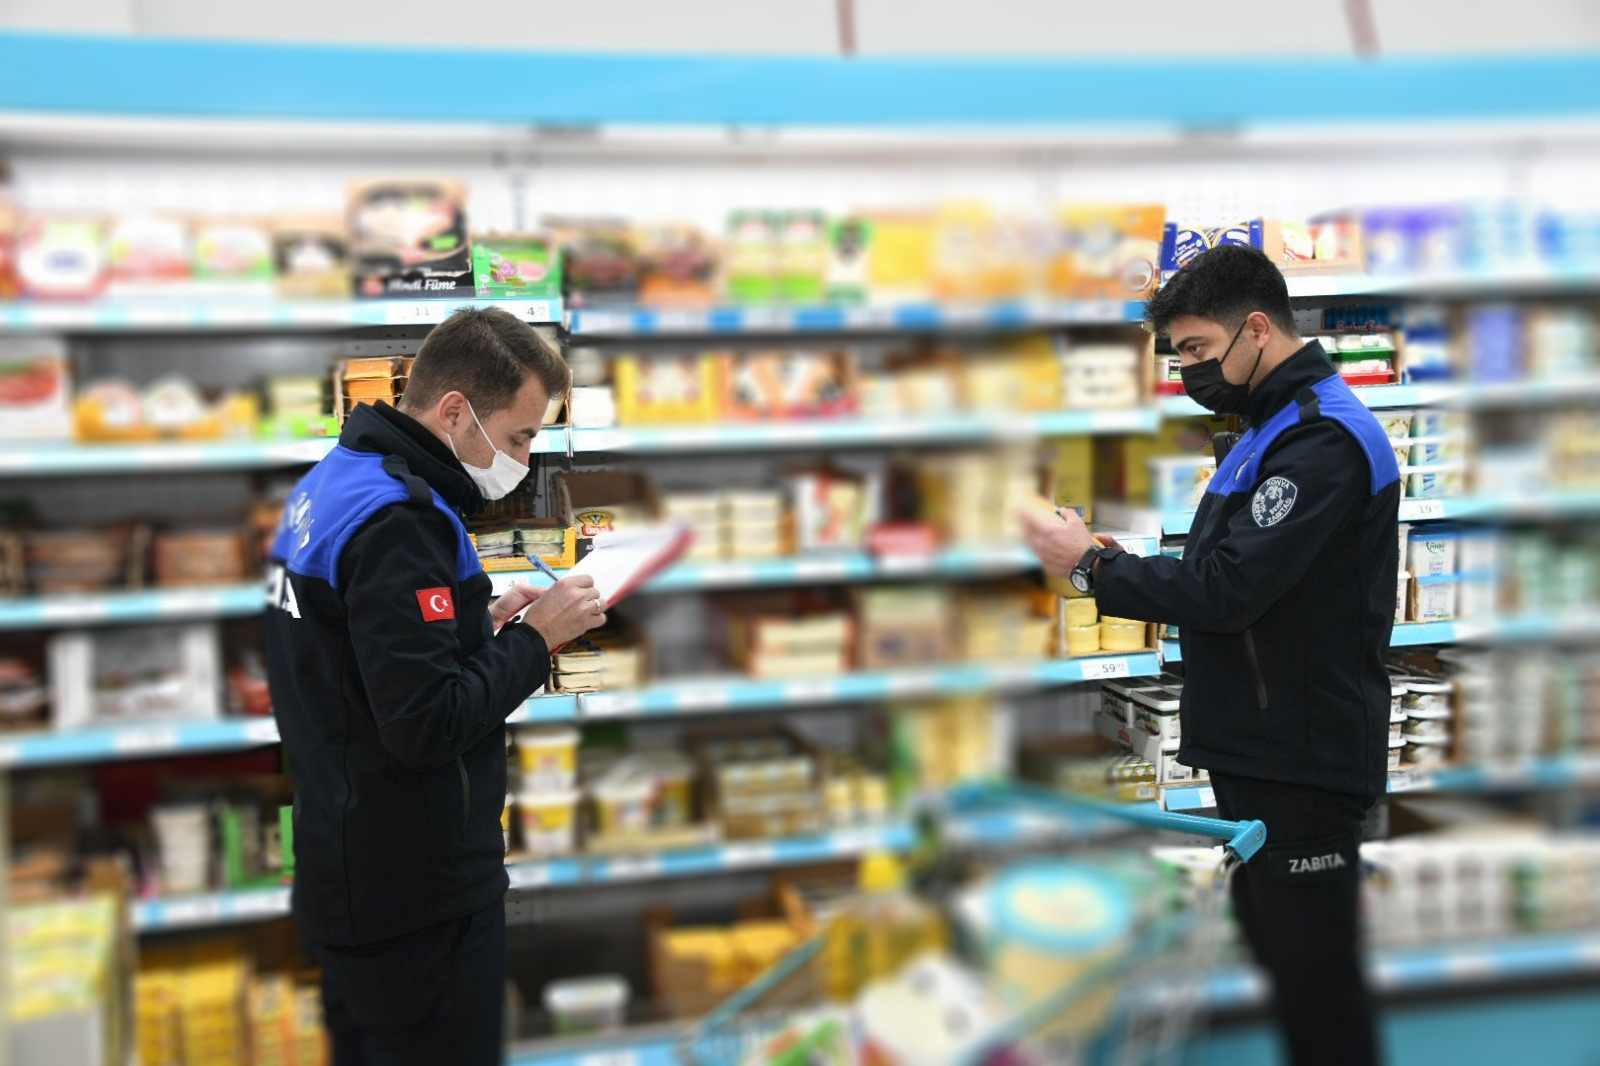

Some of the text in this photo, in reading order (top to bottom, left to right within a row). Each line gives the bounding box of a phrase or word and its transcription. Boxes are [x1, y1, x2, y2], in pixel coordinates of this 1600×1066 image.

[424, 279, 457, 291] Füme
[527, 306, 535, 316] 4
[1266, 479, 1290, 490] KONYA
[1102, 663, 1116, 673] 59
[1288, 852, 1346, 873] ZABITA
